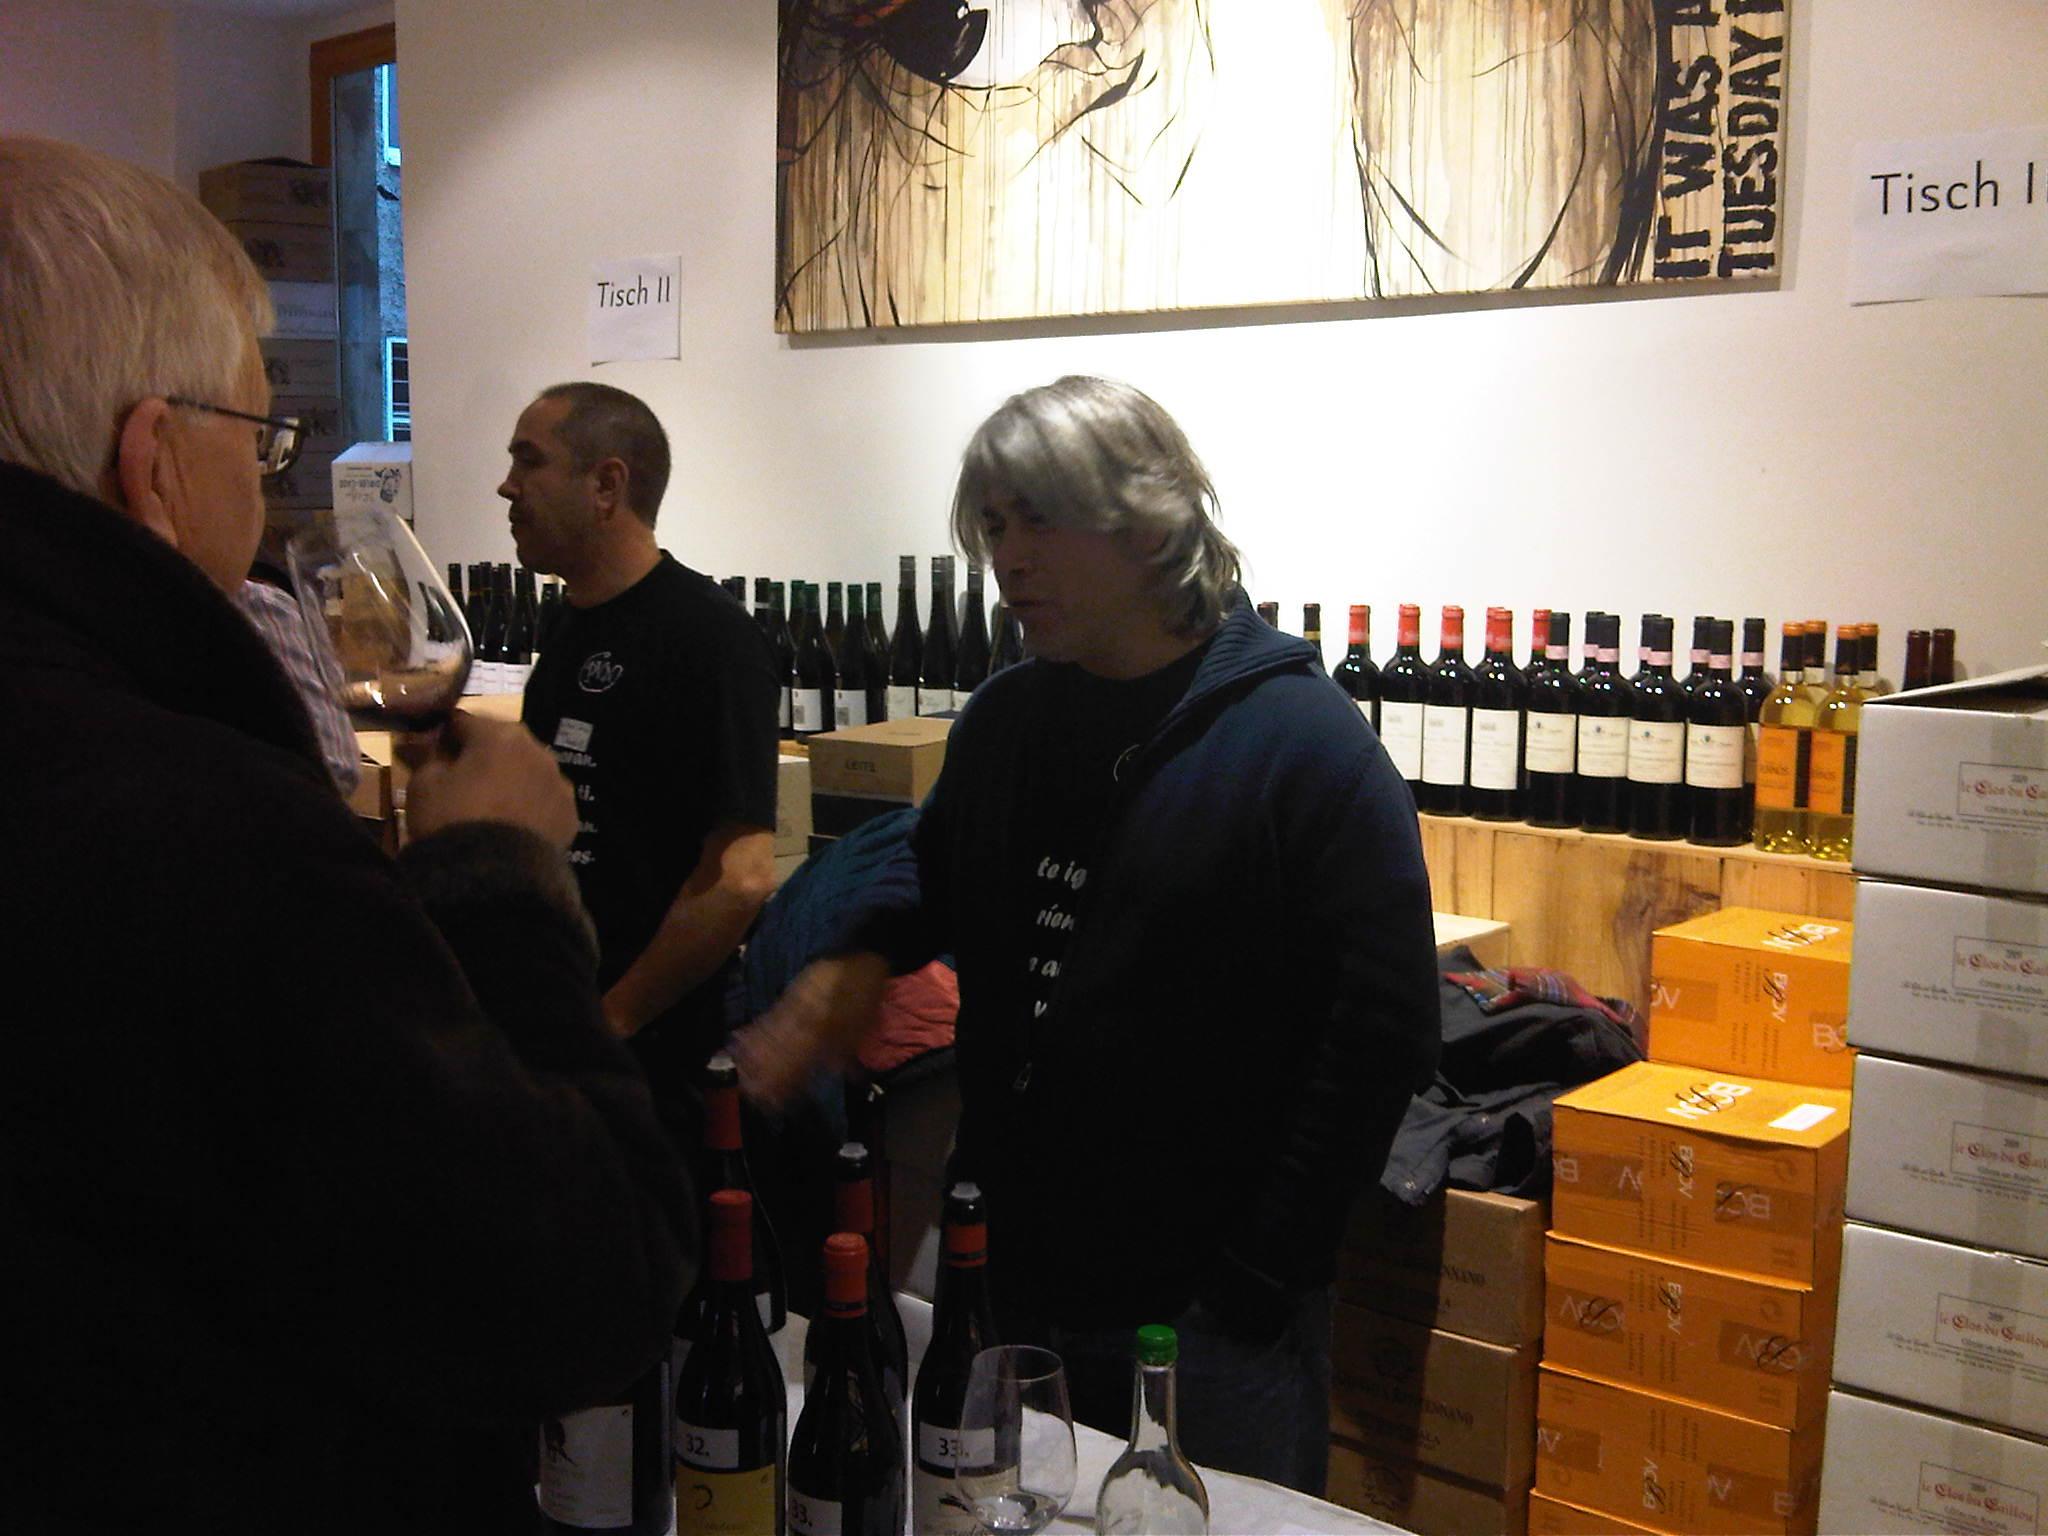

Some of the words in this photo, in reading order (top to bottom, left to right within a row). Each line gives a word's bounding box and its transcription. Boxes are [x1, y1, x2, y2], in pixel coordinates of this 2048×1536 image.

[1661, 55, 1722, 198] WAS
[1718, 26, 1783, 278] TUESDAY
[1870, 159, 1999, 215] Tisch
[1655, 216, 1711, 279] IT
[597, 274, 648, 308] Tisch
